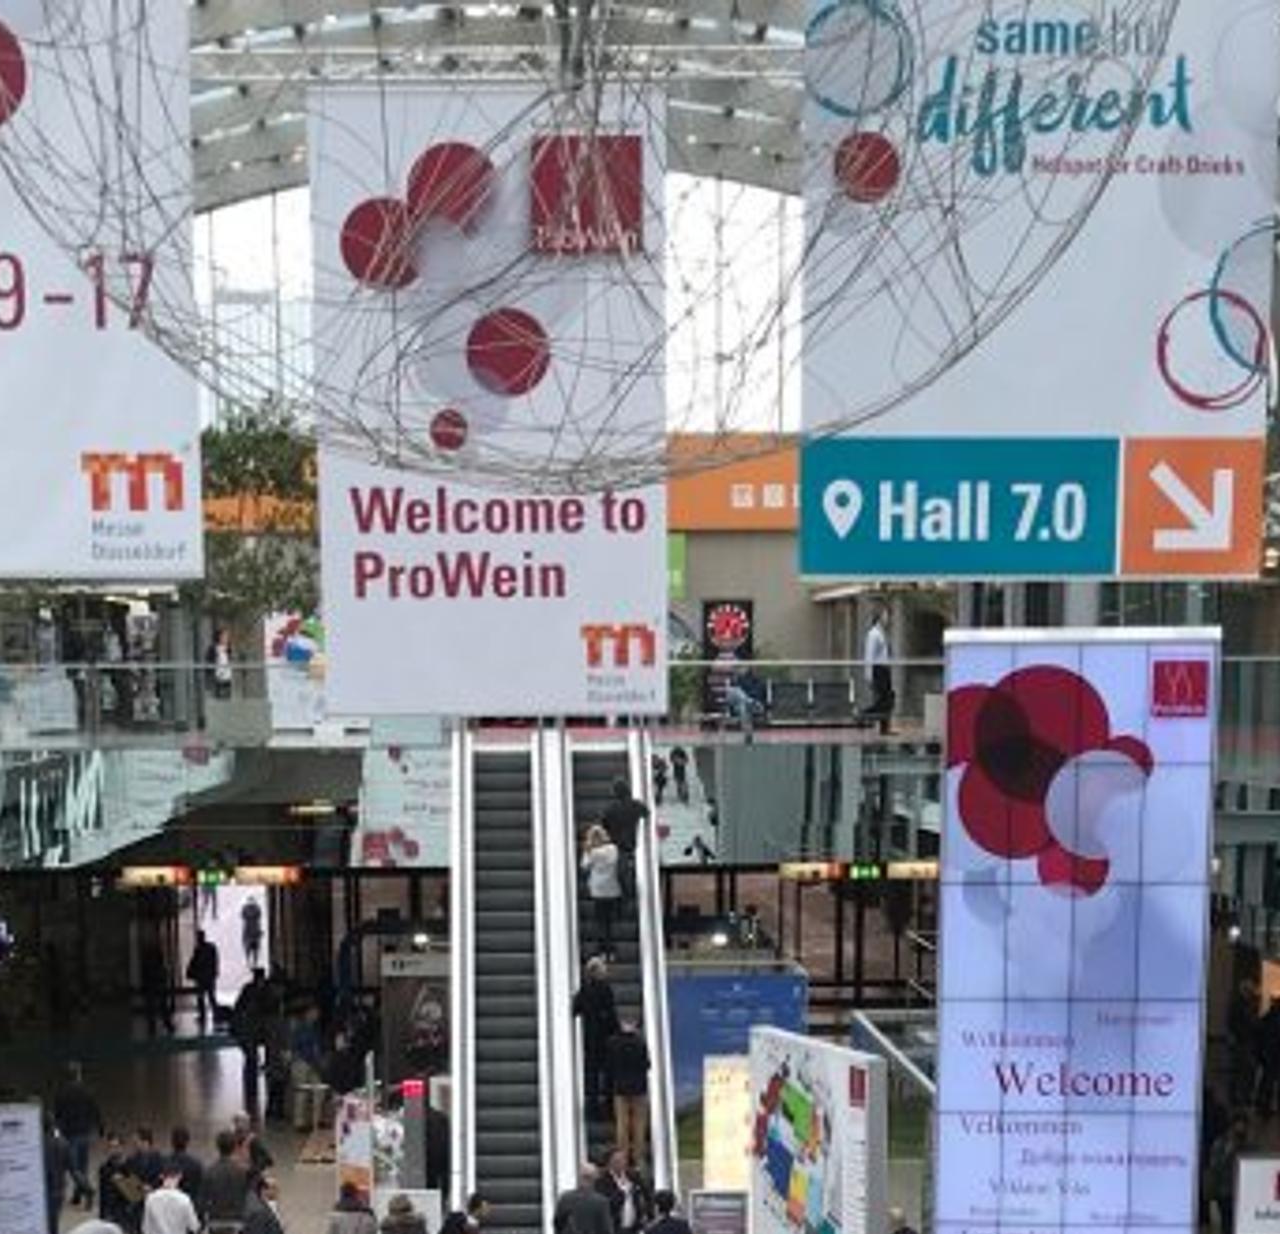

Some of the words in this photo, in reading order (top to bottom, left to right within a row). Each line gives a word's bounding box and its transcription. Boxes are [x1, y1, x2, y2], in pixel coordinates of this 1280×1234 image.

[976, 19, 1100, 55] same
[919, 53, 1194, 177] different
[349, 486, 585, 535] Welcome
[603, 491, 646, 533] to
[879, 481, 990, 542] Hall
[1010, 482, 1087, 542] 7.0
[353, 551, 567, 600] ProWein
[993, 1061, 1174, 1097] Welcome
